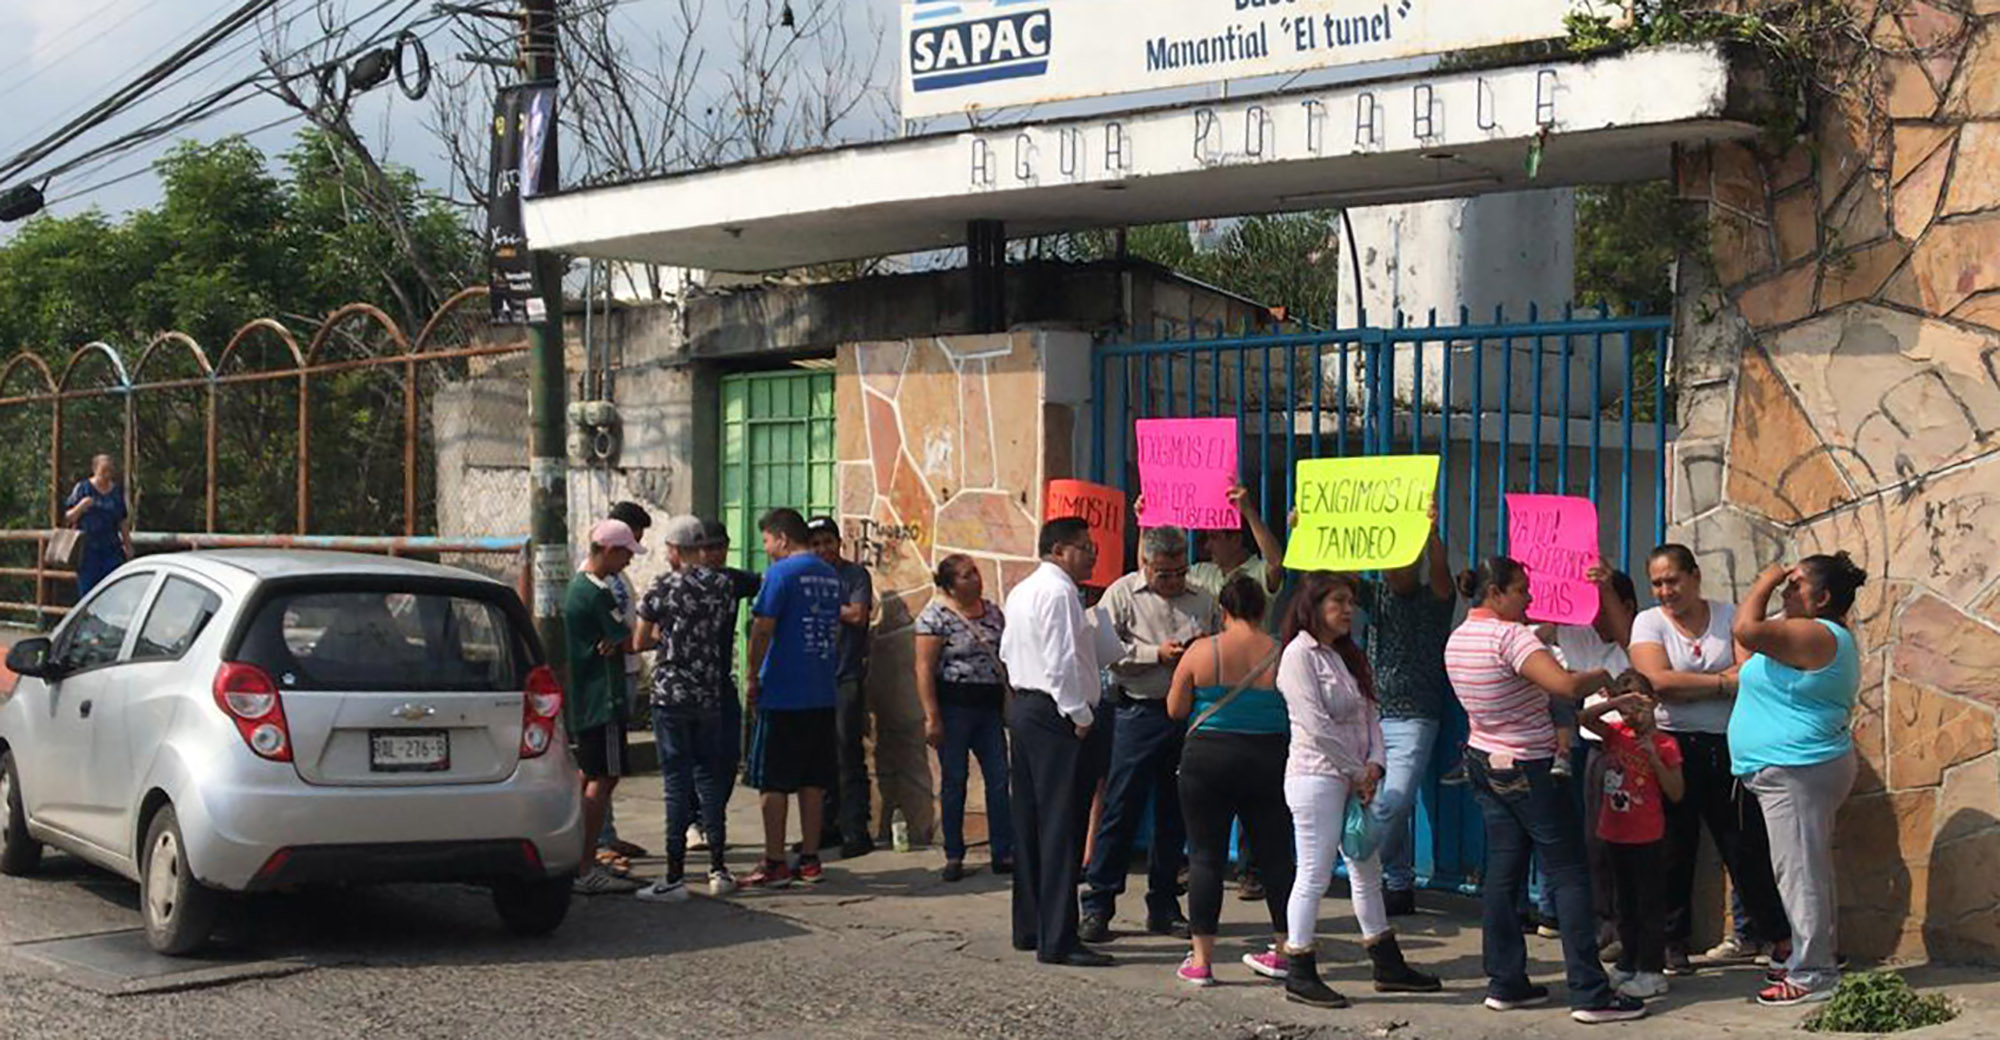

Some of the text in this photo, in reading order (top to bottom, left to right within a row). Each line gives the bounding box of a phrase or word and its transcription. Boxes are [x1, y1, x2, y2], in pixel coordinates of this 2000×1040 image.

[913, 13, 1047, 71] SAPAC
[1146, 21, 1268, 71] Manantial
[971, 69, 1557, 185] AGUA POTABLE
[1300, 476, 1402, 514] EXIGIMOS
[1316, 525, 1397, 560] TANDEO
